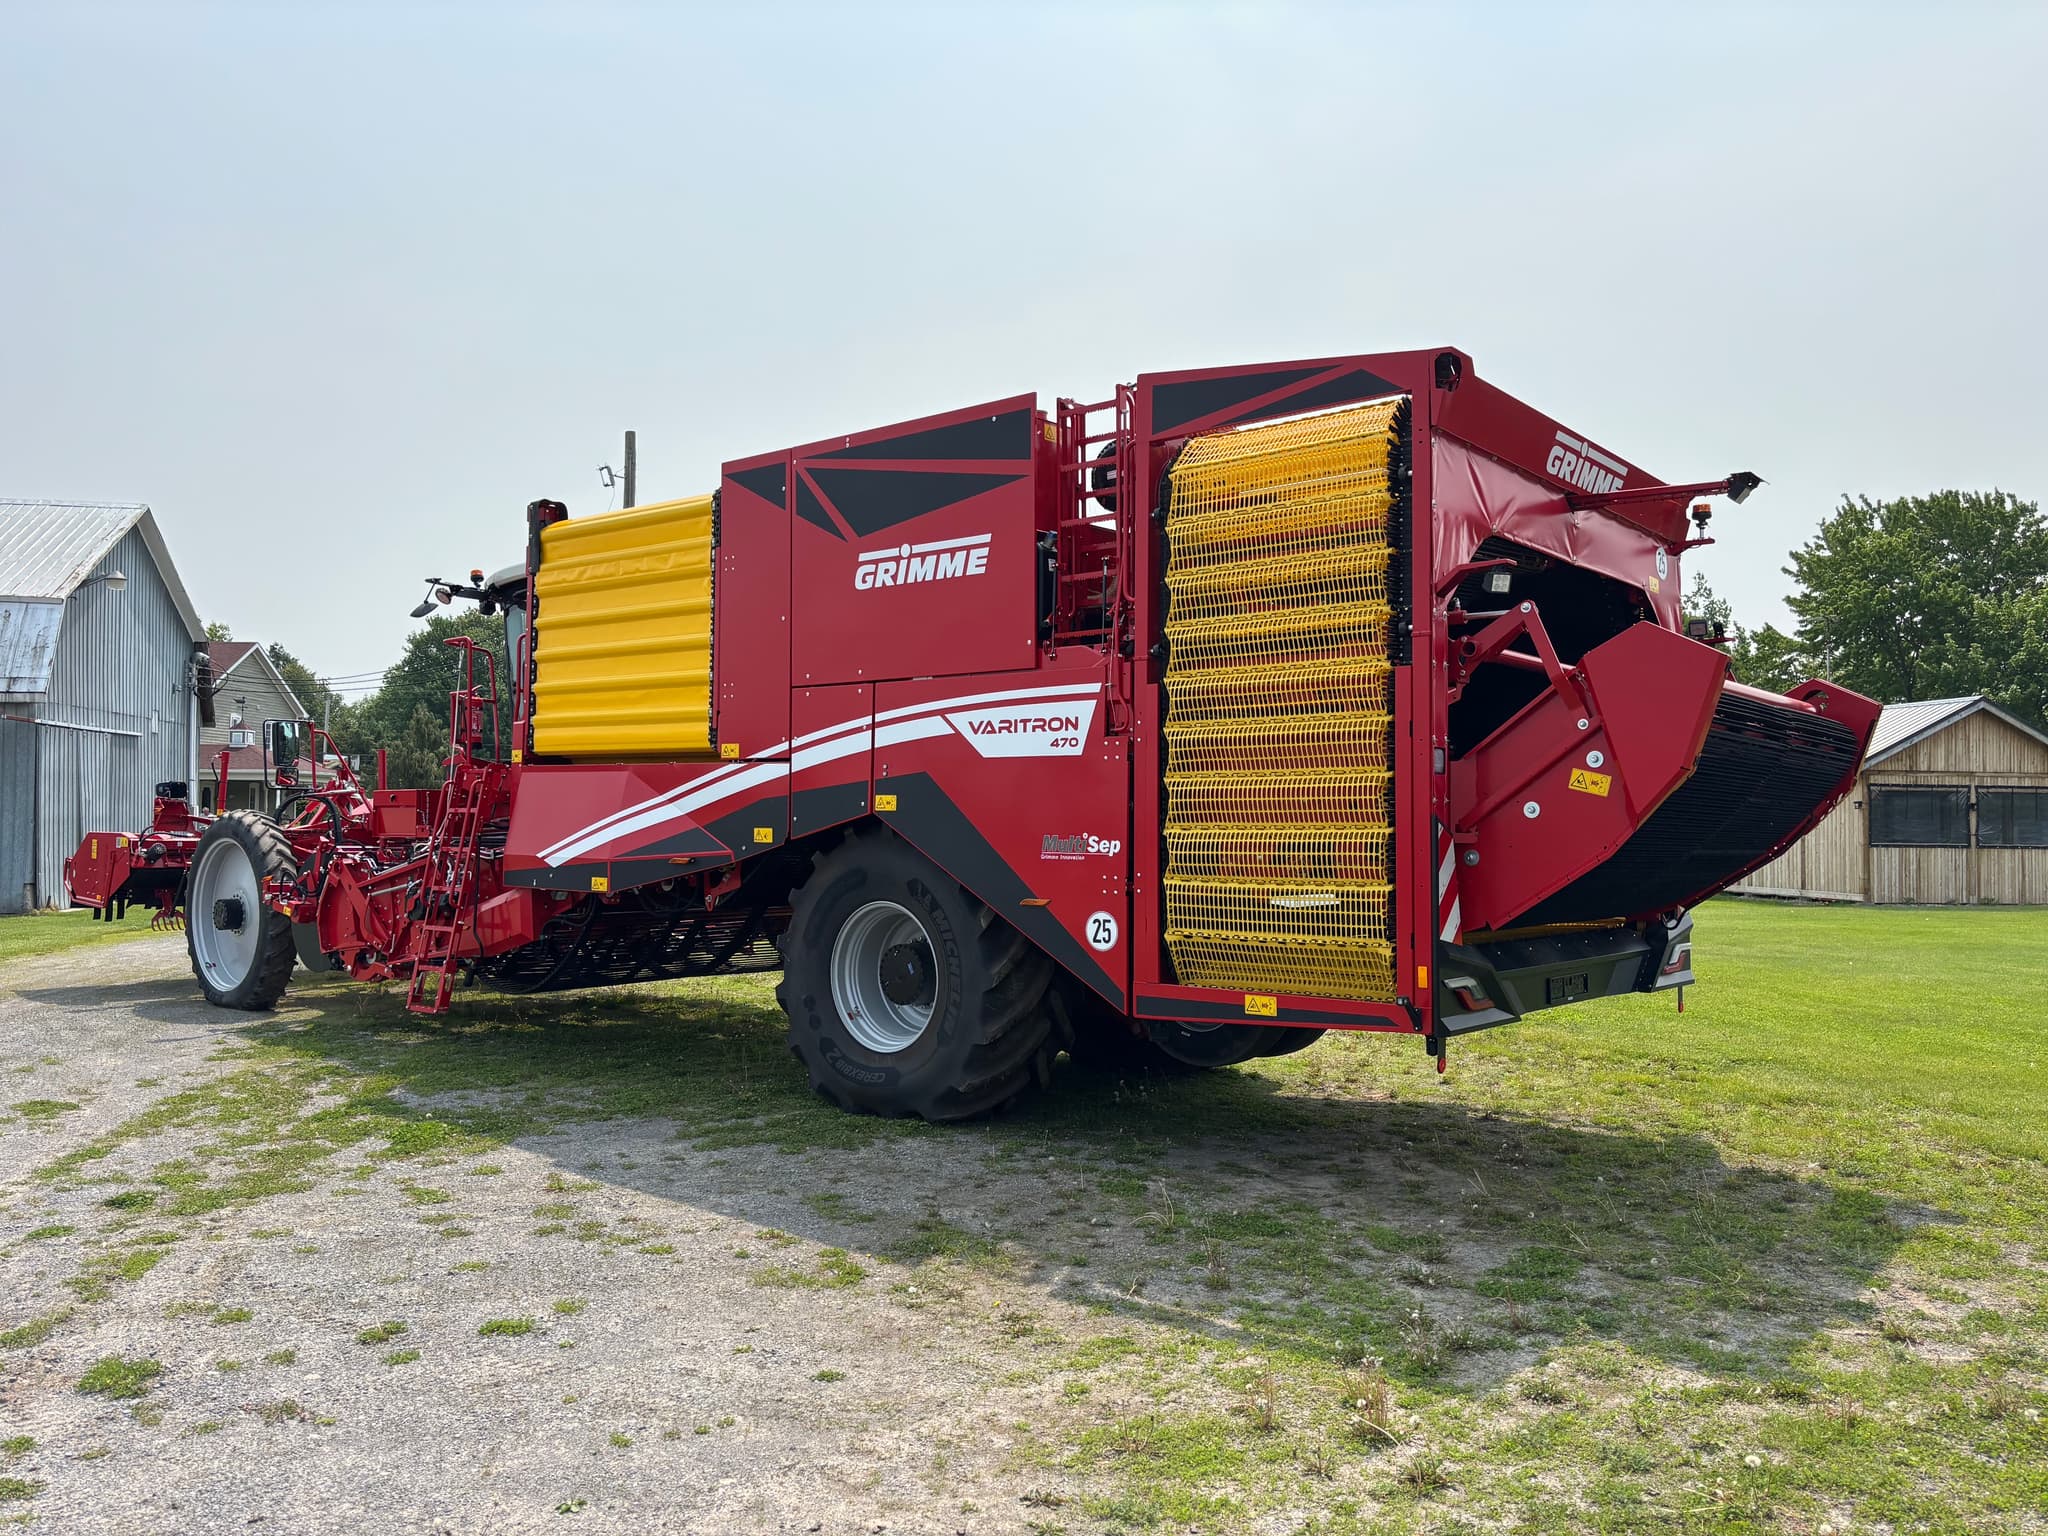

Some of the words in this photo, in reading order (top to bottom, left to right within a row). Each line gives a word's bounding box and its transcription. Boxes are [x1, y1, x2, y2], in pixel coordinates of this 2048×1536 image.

[854, 542, 991, 591] GRIMME
[968, 716, 1079, 735] VARITRON
[1049, 737, 1079, 748] 470
[1092, 918, 1112, 944] 25
